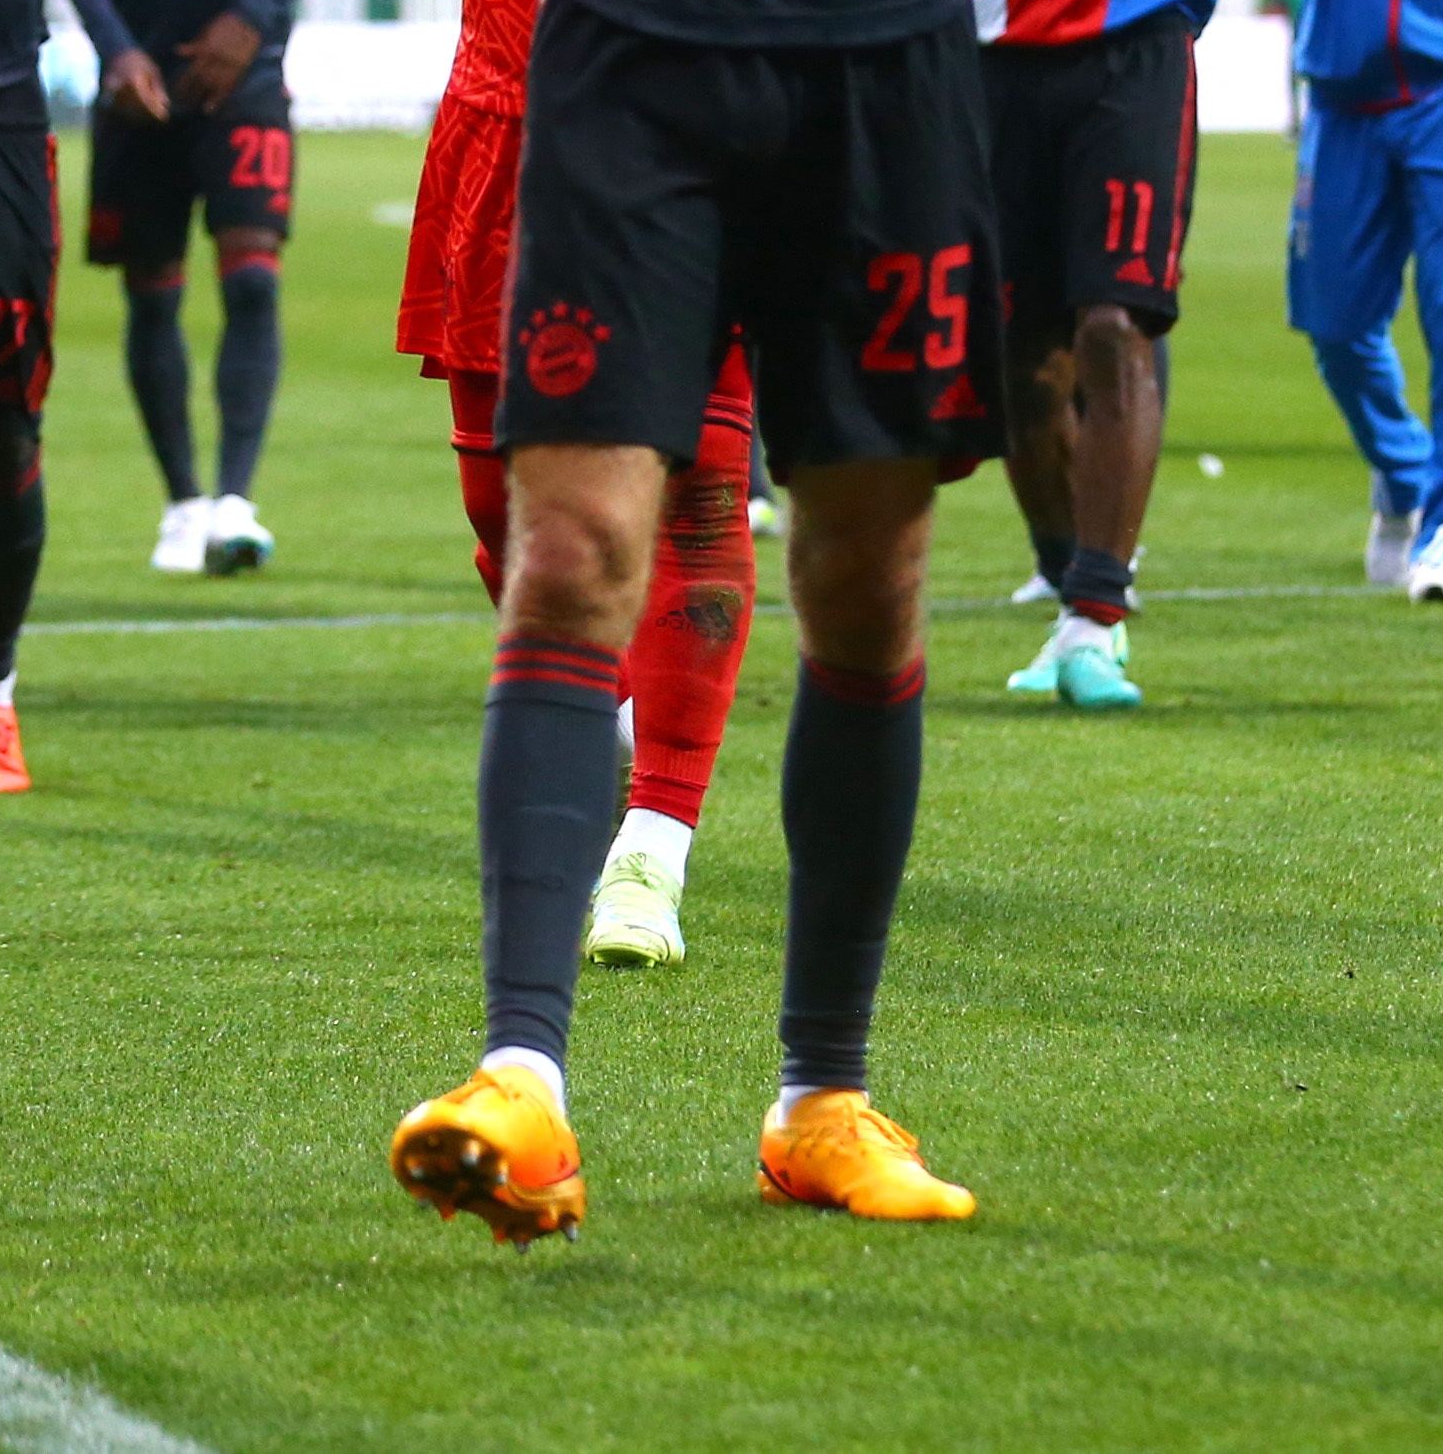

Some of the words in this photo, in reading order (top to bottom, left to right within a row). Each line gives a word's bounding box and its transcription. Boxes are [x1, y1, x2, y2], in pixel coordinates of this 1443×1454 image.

[230, 126, 291, 188] 20
[1105, 178, 1154, 254] 11
[861, 243, 971, 371] 25
